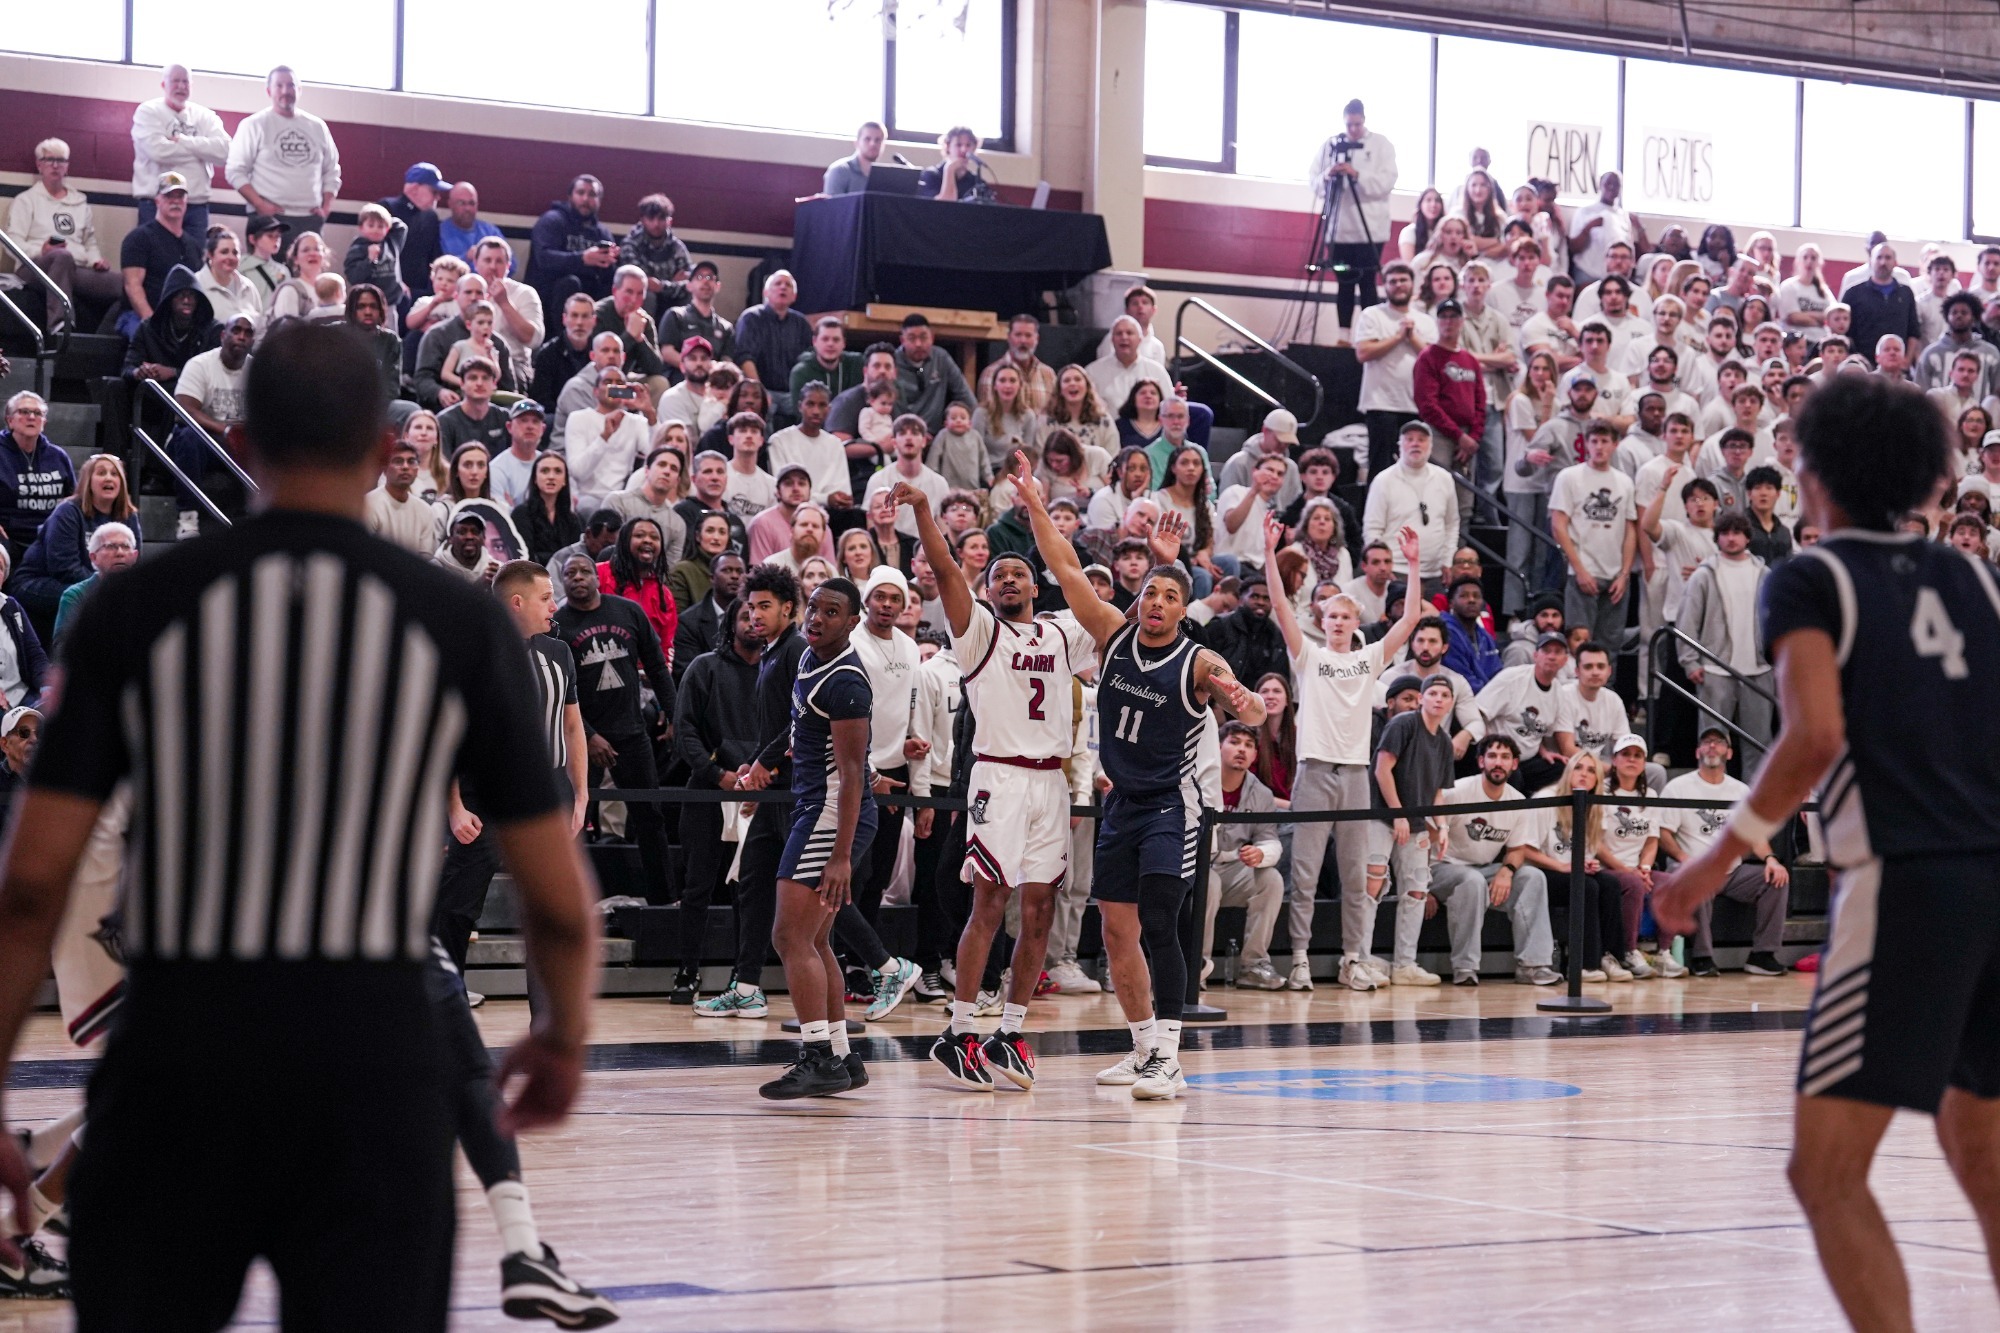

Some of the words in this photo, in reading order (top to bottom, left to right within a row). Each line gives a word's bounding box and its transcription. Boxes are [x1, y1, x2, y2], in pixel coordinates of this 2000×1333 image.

[1527, 124, 1601, 194] CAIRN
[1643, 135, 1714, 202] CRAZIES
[18, 471, 62, 483] PRIDE
[19, 484, 64, 496] SPIRIT
[17, 499, 60, 510] HONO
[610, 625, 632, 640] CITY
[1909, 586, 1969, 679] 4
[1012, 652, 1056, 673] CAIRN
[1029, 677, 1046, 721] 2
[1109, 673, 1168, 708] Harrisburg
[1115, 705, 1144, 744] 11
